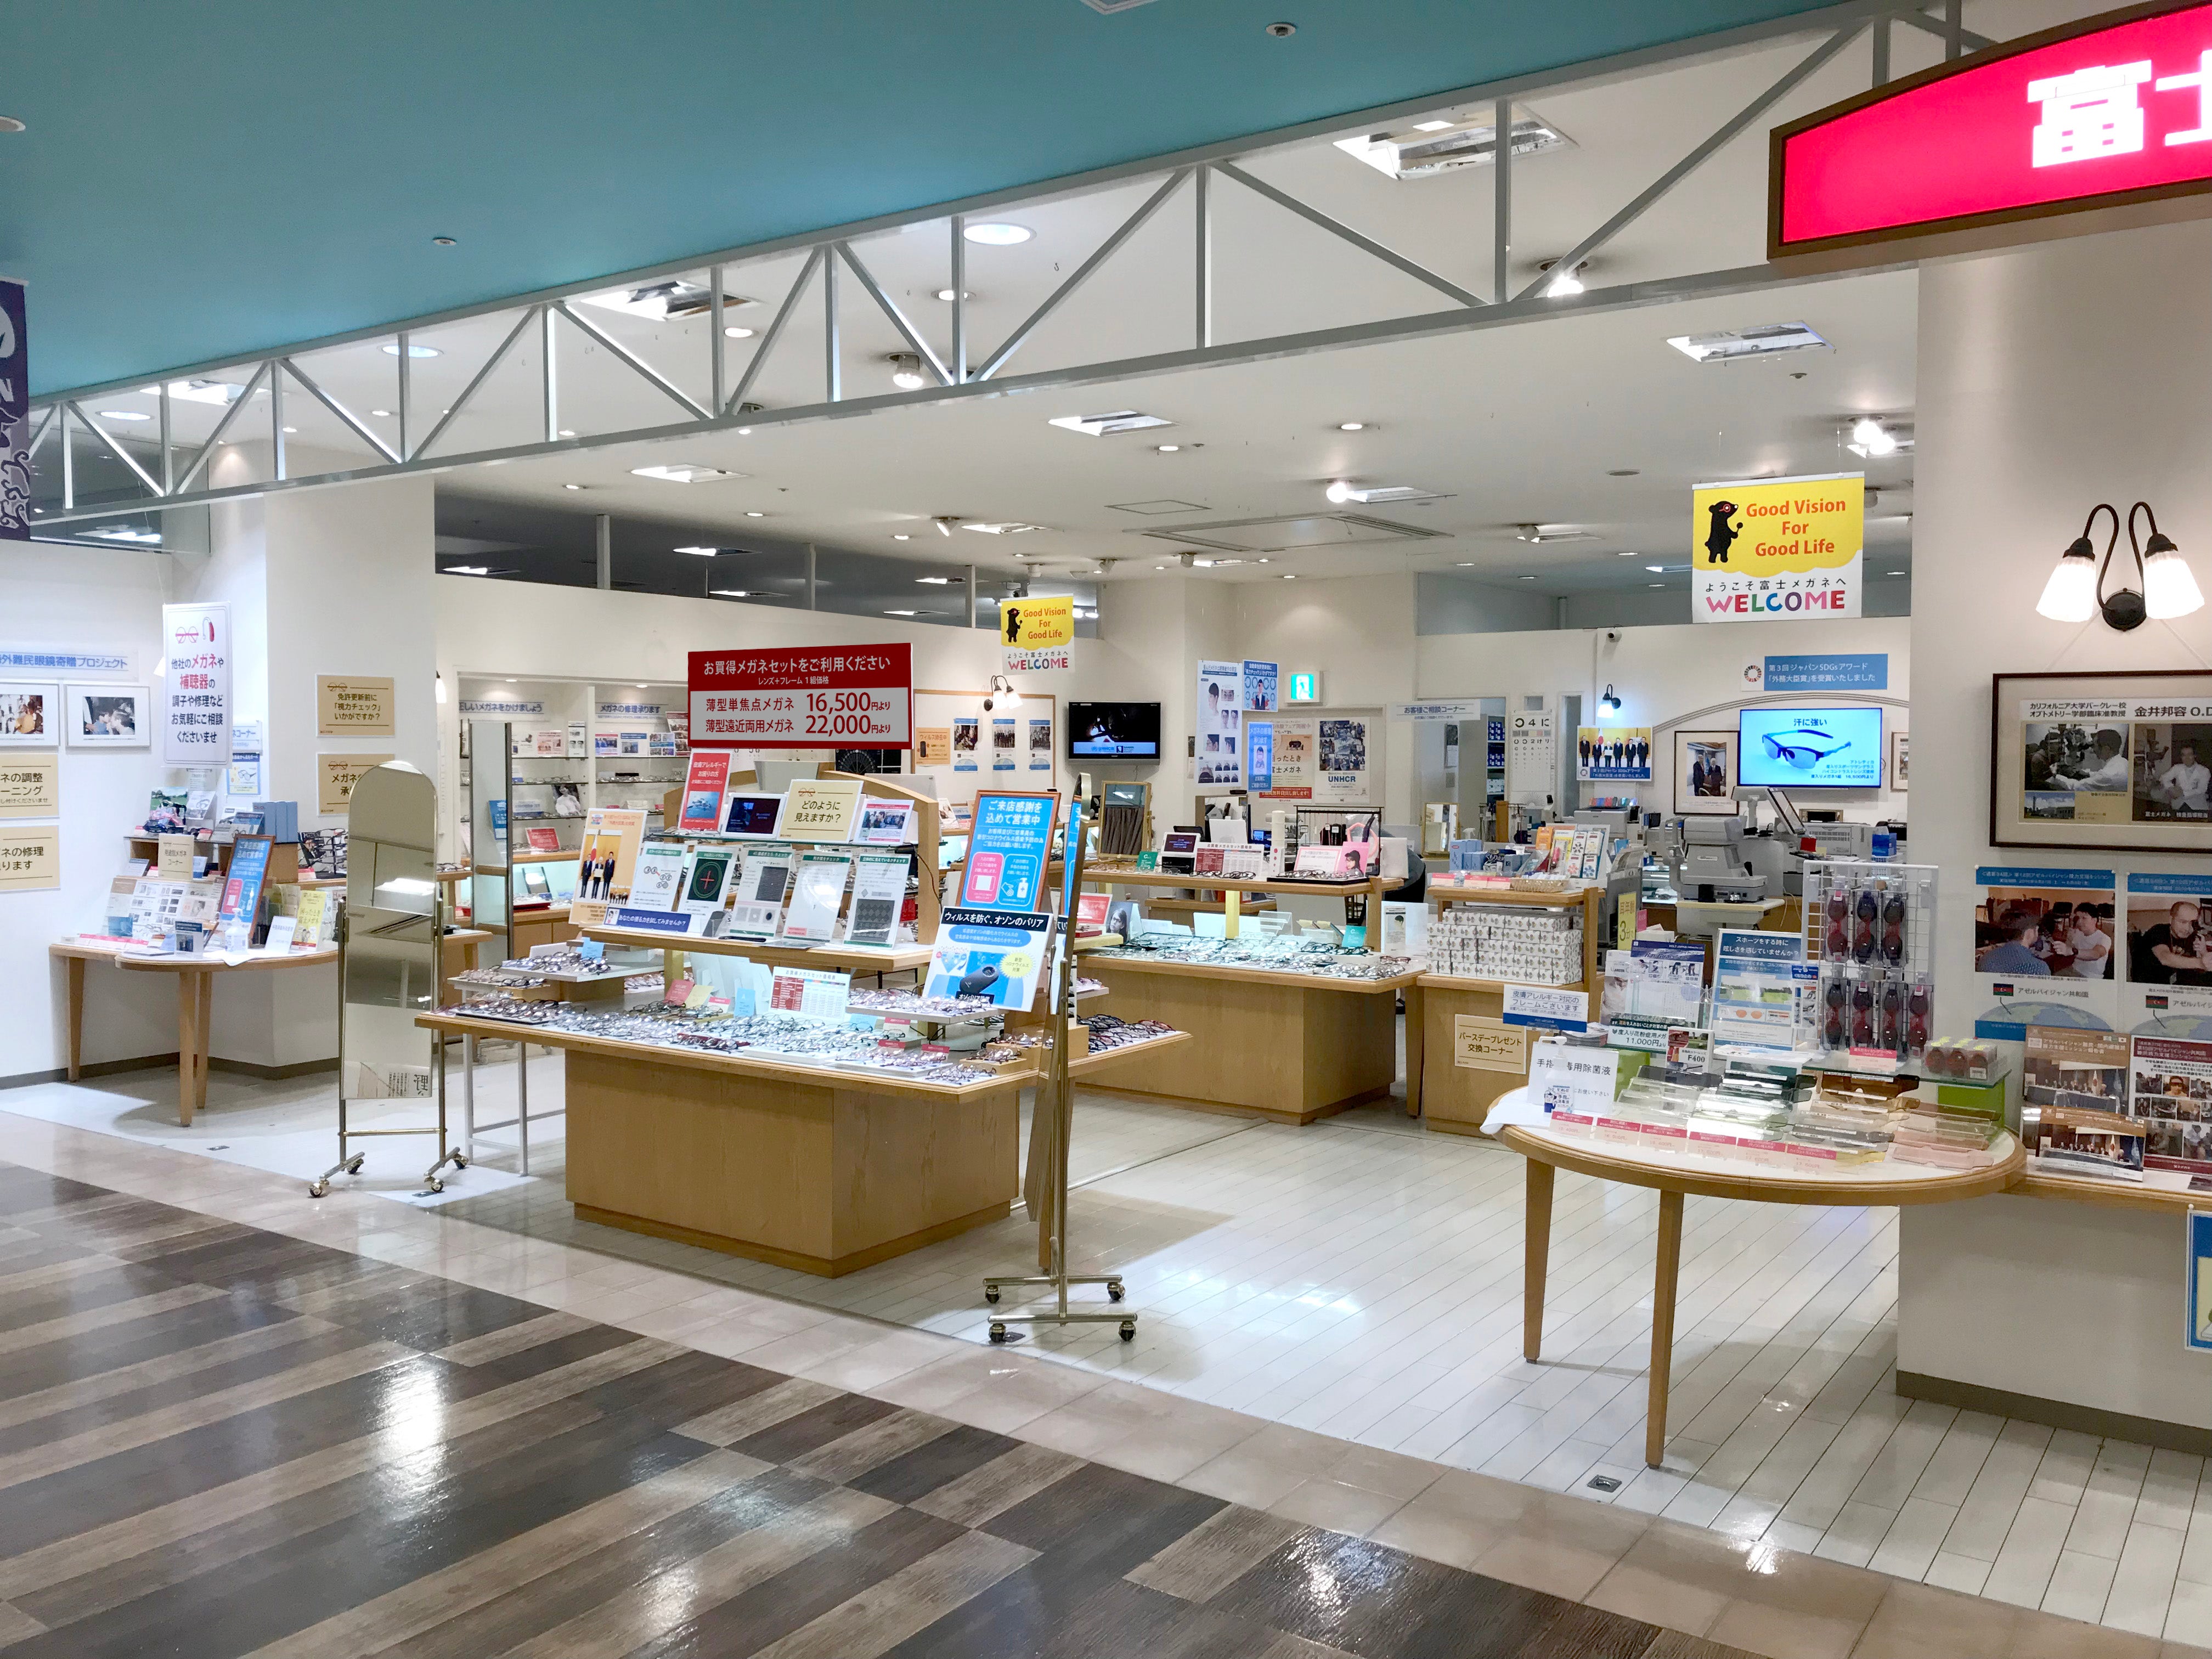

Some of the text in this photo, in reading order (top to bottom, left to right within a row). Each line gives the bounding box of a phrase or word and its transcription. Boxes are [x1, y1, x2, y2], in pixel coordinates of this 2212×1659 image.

[1746, 498, 1846, 517] Good Vision
[1782, 521, 1809, 535] For
[1755, 538, 1835, 556] Good Life
[1705, 577, 1847, 592] ようこそ富士メガネへ
[1706, 590, 1845, 613] WELCOME
[1024, 607, 1066, 618] Good Vision
[1028, 631, 1047, 639] Good
[0, 654, 127, 669] 外難民眼鏡寄贈プロジェクト
[171, 654, 224, 670] 他社のメガネや
[704, 656, 890, 675] お買得メガネセットをご利用ください
[1008, 658, 1068, 670] WELCOME
[180, 674, 215, 690] 補聴器の
[1768, 673, 1875, 682] 「外務大臣賞」を受賞いたしました
[172, 695, 223, 708] 調子や修理など
[335, 703, 380, 711] 「視力チェック」
[601, 704, 660, 713] メガネの修理承ります
[706, 697, 794, 712] 薄型単焦点メガネ
[806, 692, 890, 715] 16,500円より
[2134, 706, 2187, 717] 金井邦容
[171, 713, 223, 726] お気軽にご相談
[706, 719, 794, 733] 薄型遠近両用メガネ
[806, 715, 890, 737] 22,000円より
[1793, 718, 1827, 726] 汗に強い
[177, 731, 217, 743] くださいませ
[802, 800, 840, 810] どのように
[988, 800, 1042, 814] ご来店感謝を
[985, 812, 1041, 826] 込めて営業中
[0, 860, 32, 870] ります
[945, 912, 1043, 928] ウィルスを防ぐ、オゾンのバリア
[1513, 991, 1579, 1003] 皮膚アレルギー対応の
[1513, 999, 1578, 1011] フレームございます
[1459, 1032, 1521, 1046] バースデープレゼント
[1468, 1044, 1513, 1054] 交換コーナー
[1537, 1059, 1611, 1075] 手指毒用除菌液
